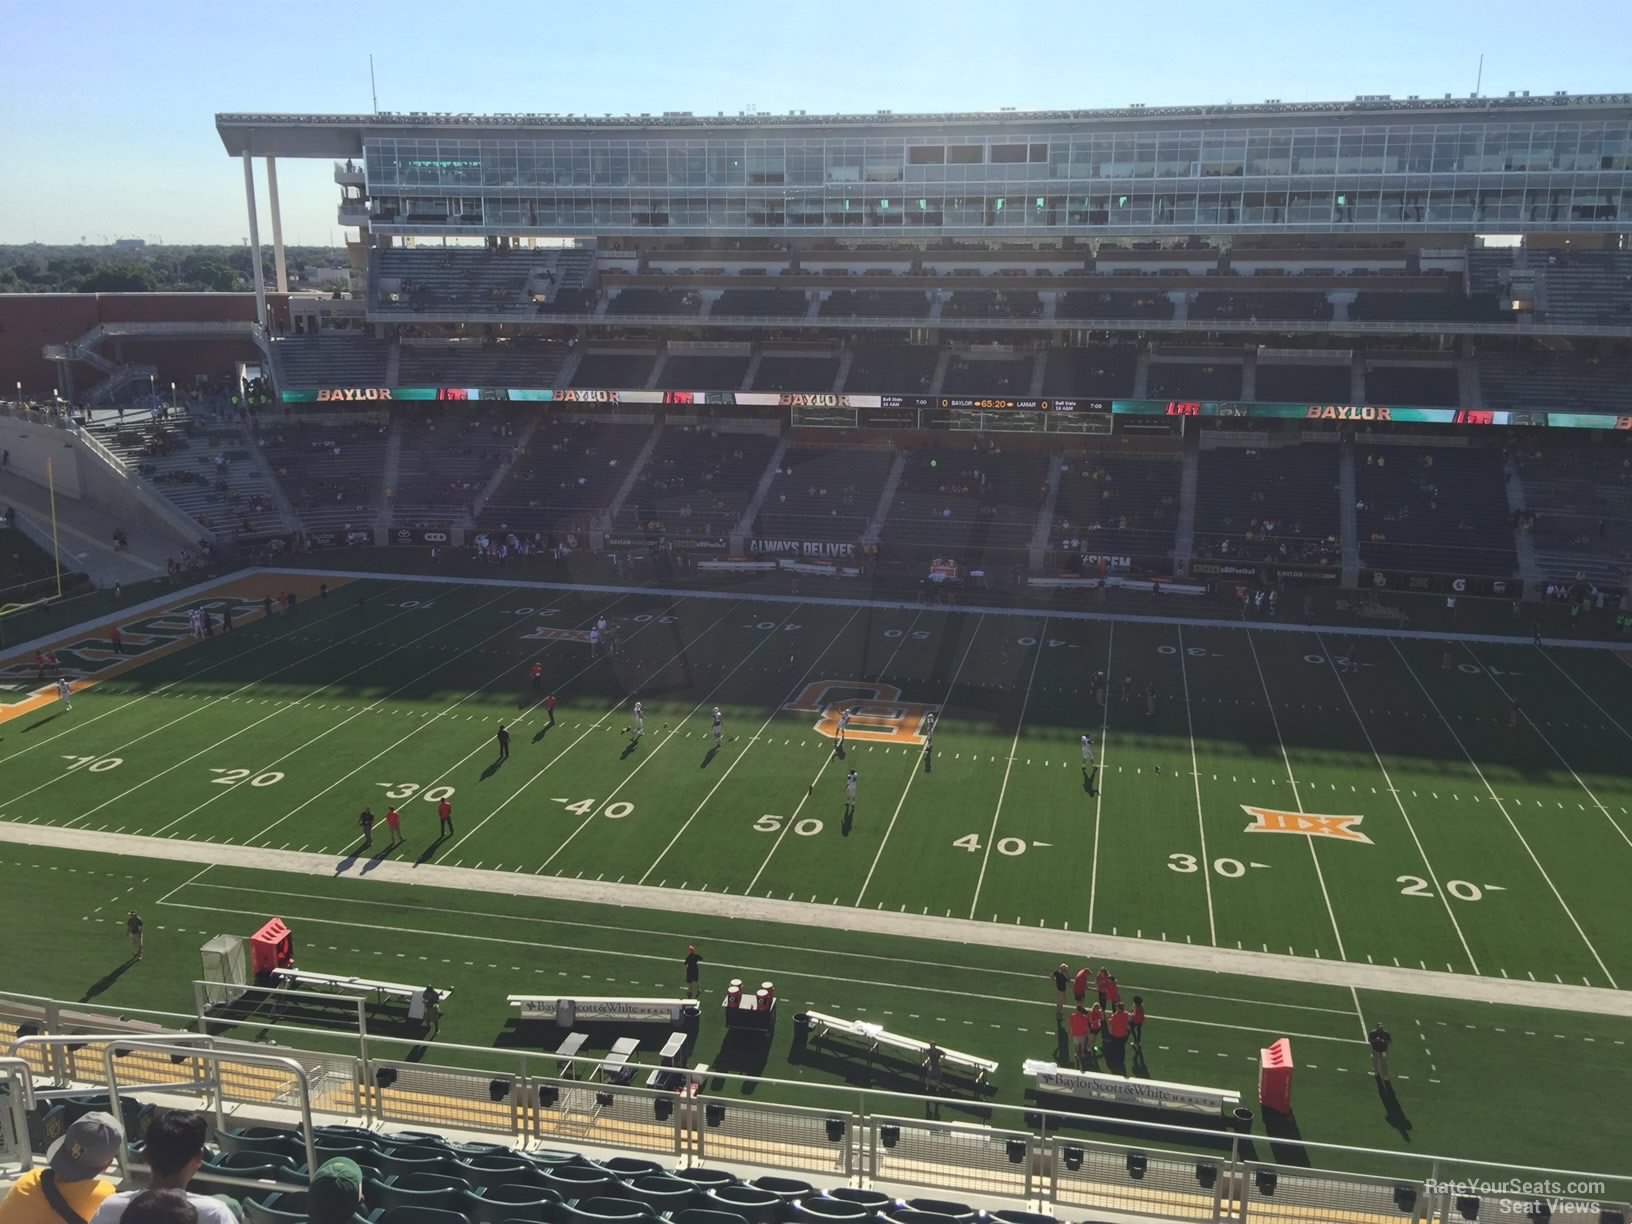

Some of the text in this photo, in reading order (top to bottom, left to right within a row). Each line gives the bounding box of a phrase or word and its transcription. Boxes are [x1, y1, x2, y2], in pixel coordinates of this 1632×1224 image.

[317, 389, 393, 400] BAYLOR
[552, 390, 620, 403] BAYLOR
[779, 394, 850, 408] BAYLOR
[942, 399, 948, 407] 0
[981, 400, 1006, 408] 65:20
[1041, 401, 1048, 409] 0
[1305, 405, 1392, 421] BAYLOR
[750, 539, 800, 553] ALWAYS
[66, 755, 124, 772] 10
[210, 768, 285, 787] 20
[386, 782, 456, 802] 30
[564, 798, 635, 819] 40
[752, 814, 824, 836] 50
[952, 833, 1027, 856] 40
[1167, 853, 1246, 878] 30
[1396, 875, 1483, 901] 20
[1172, 1094, 1215, 1106] HEALTH
